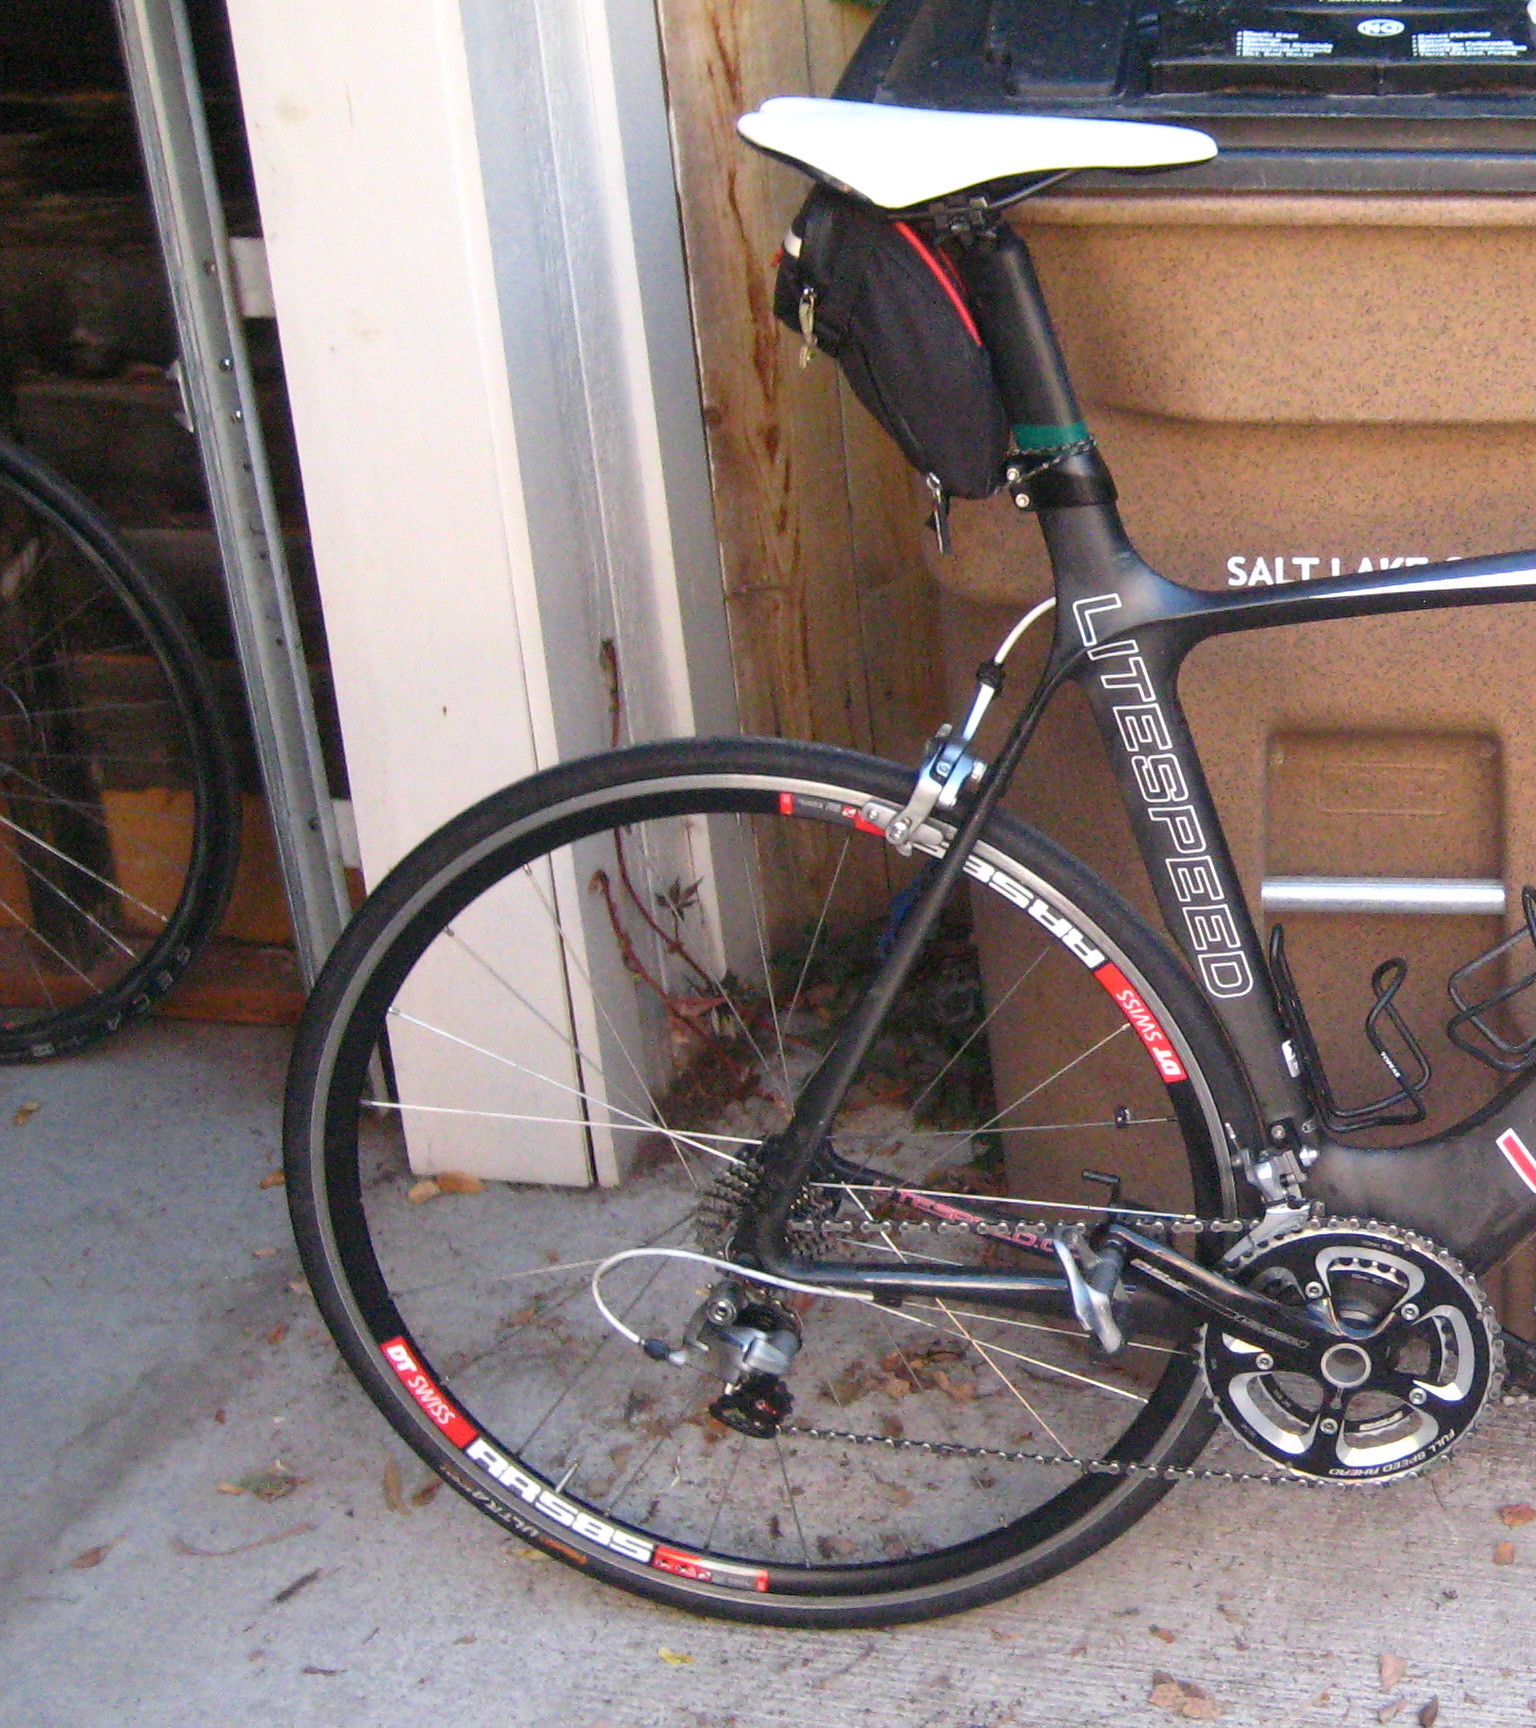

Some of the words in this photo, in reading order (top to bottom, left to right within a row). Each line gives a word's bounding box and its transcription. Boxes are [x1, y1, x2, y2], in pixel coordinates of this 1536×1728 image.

[1227, 557, 1320, 586] SALT
[1331, 557, 1429, 577] LA
[1072, 593, 1253, 998] LITESPEED
[1115, 988, 1163, 1044] SWISS
[1151, 1045, 1182, 1077] DT
[386, 1344, 415, 1373] DT
[408, 1373, 456, 1425] SWISS
